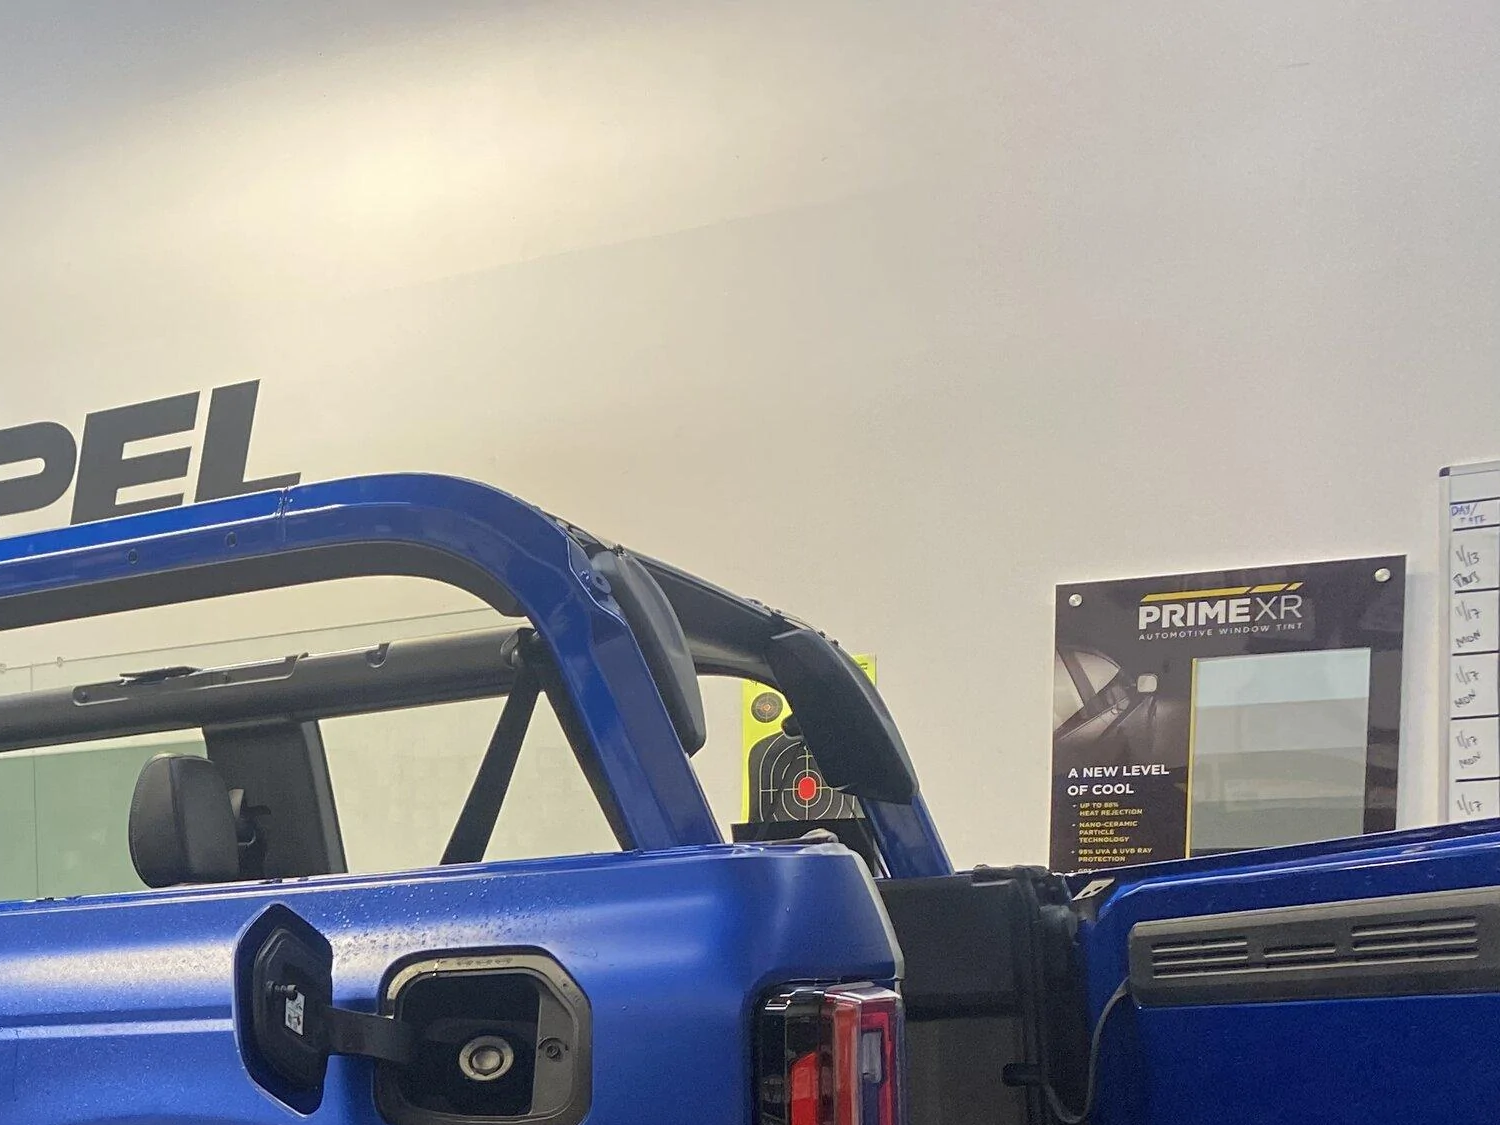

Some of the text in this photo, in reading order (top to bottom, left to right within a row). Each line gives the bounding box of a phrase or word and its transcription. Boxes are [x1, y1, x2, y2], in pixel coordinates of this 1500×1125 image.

[1139, 622, 1303, 641] AUTOMOTIVE WINDOW TINT
[1067, 764, 1170, 778] A NEW LEVEL
[1067, 783, 1134, 796] OF COOL
